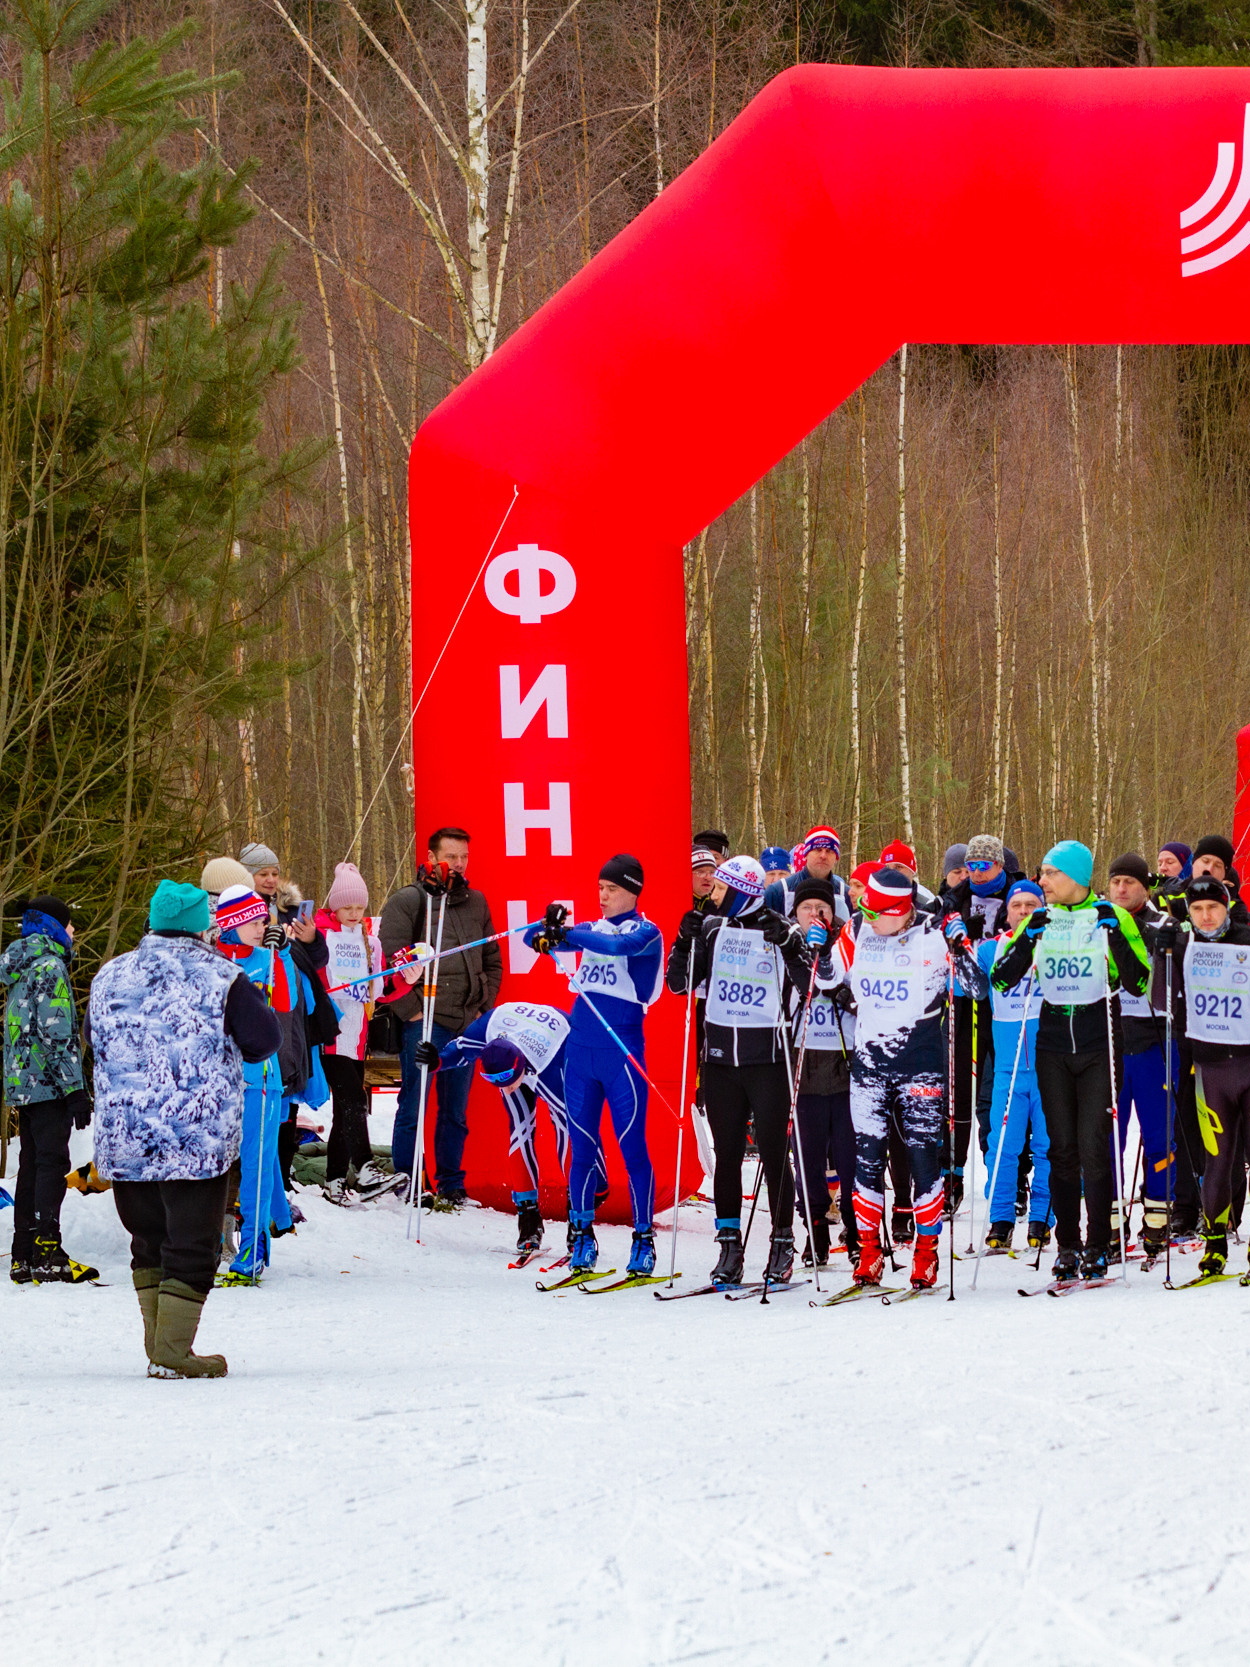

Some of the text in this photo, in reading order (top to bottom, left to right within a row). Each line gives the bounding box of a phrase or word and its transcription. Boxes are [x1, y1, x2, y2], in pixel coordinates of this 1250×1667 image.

[227, 904, 266, 926] ЛЫЖНЯ
[723, 938, 751, 948] ЛЫЖНЯ
[336, 950, 361, 959] РОССИИ
[721, 946, 750, 956] РОССИИ
[1193, 951, 1224, 959] ЛЫЖНЯ
[719, 954, 747, 966] 2023
[1192, 958, 1223, 967] РОССИИ
[1044, 956, 1093, 979] 3662
[1191, 966, 1222, 978] 2023
[580, 963, 617, 985] 3615
[718, 979, 767, 1008] 3882
[860, 978, 909, 1001] 9425
[1194, 993, 1242, 1019] 9212
[514, 1005, 561, 1031] 3618
[1206, 1023, 1230, 1031] МОСКВА
